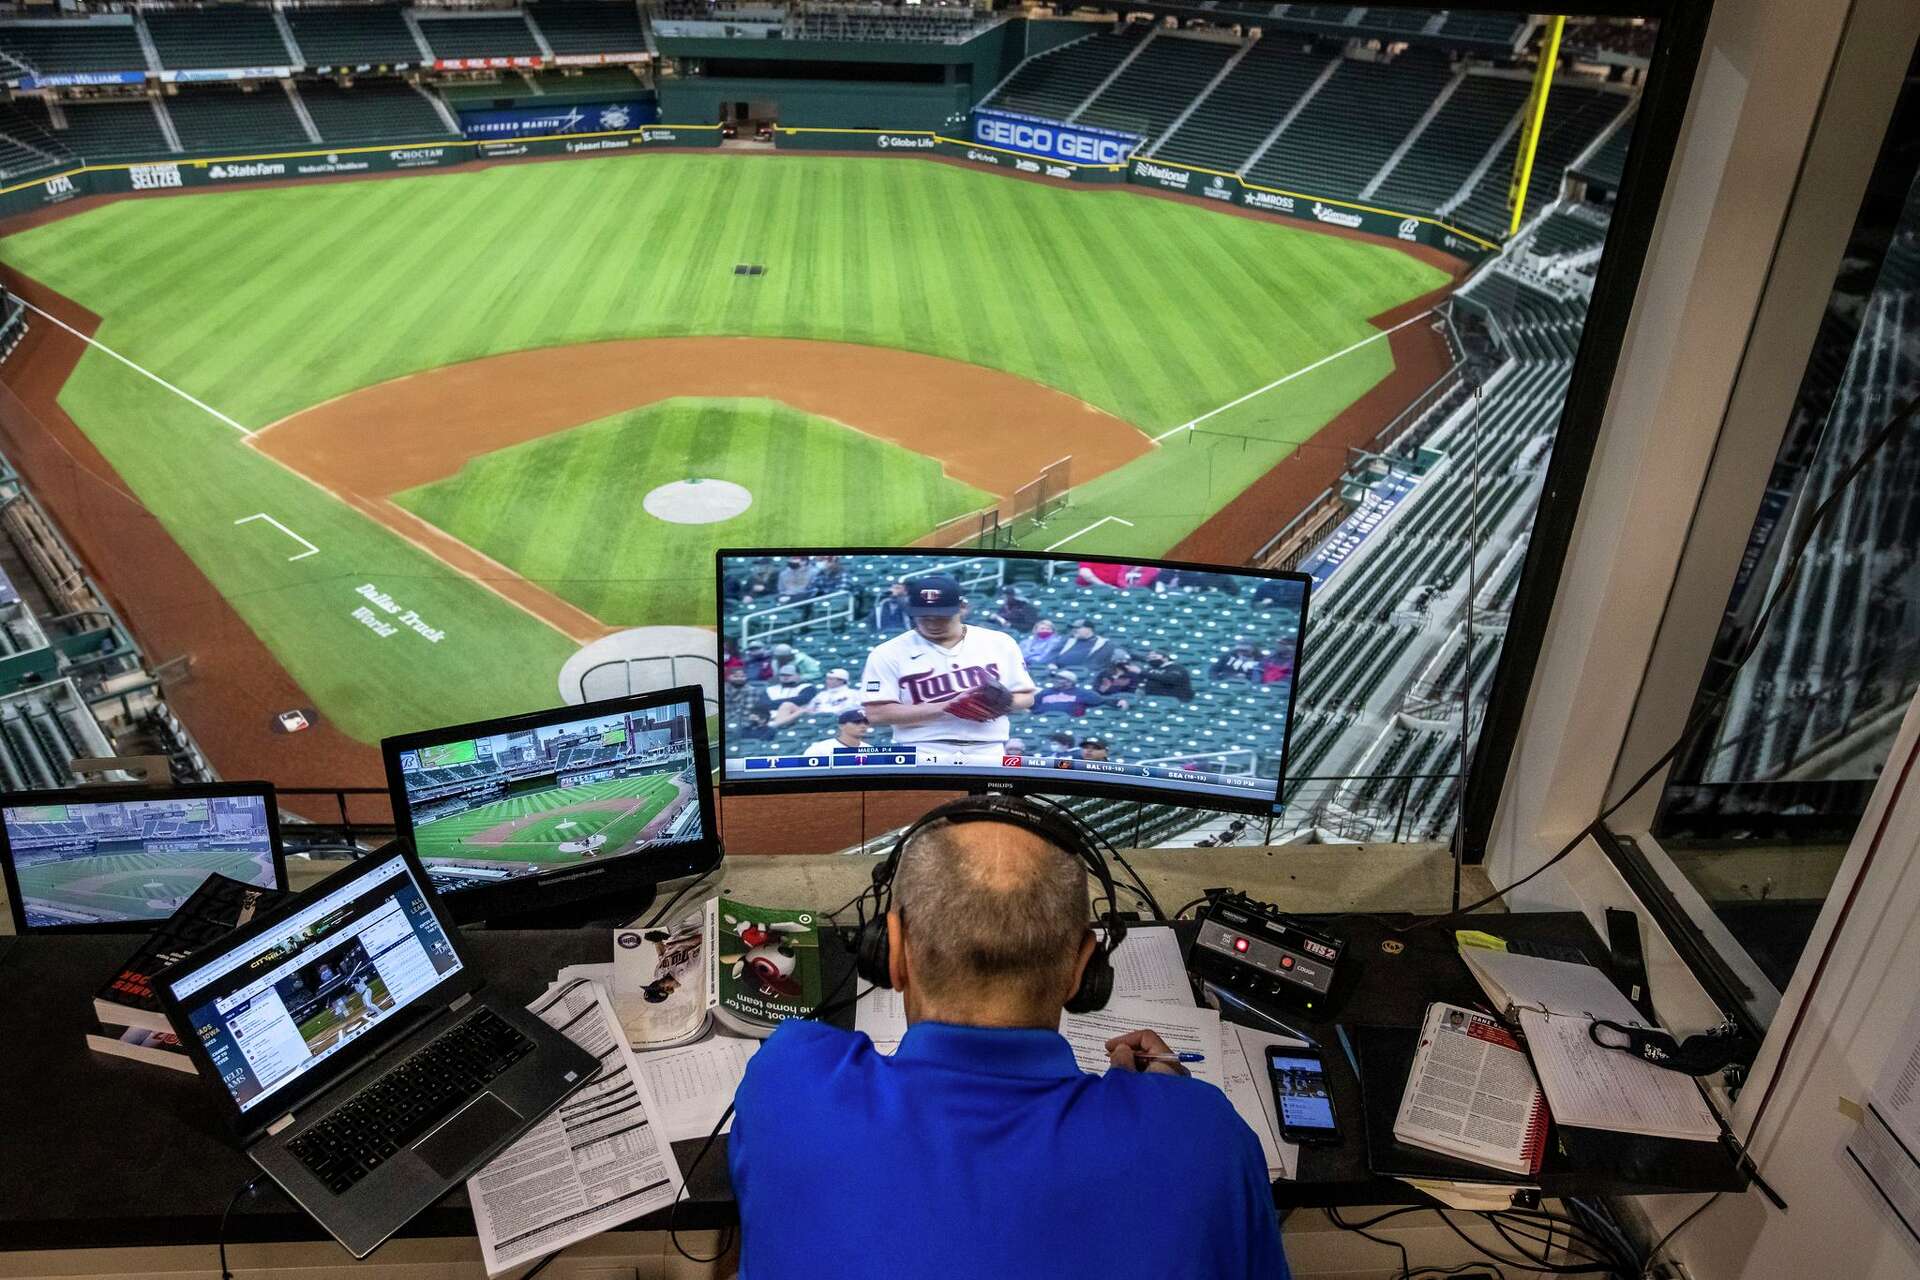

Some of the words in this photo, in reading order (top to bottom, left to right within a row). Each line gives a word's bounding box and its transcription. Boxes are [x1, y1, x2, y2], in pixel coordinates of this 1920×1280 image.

[34, 74, 123, 87] SWIN-WILLIAMS
[467, 122, 519, 132] LOCKHEED
[522, 119, 559, 128] MARTIN
[977, 119, 1052, 151] GEICO
[574, 142, 600, 152] planet
[601, 140, 629, 150] fitness
[891, 137, 917, 147] Globe
[917, 138, 934, 148] Life
[395, 149, 444, 160] CHOCTAW
[132, 171, 183, 190] SELTZER
[1148, 165, 1190, 184] National
[46, 176, 74, 195] UTA
[355, 583, 402, 614] Dallas
[398, 610, 446, 643] Truck
[351, 606, 398, 638] World
[898, 663, 1000, 706] Twins
[766, 758, 780, 769] T
[808, 757, 820, 767] 0
[894, 755, 906, 765] 0
[1086, 763, 1101, 771] BAL
[1296, 965, 1316, 975] COUGH
[726, 998, 740, 1010] for
[736, 993, 764, 1008] team
[741, 1004, 763, 1016] root
[766, 1001, 797, 1014] home
[764, 1010, 791, 1020] oot,
